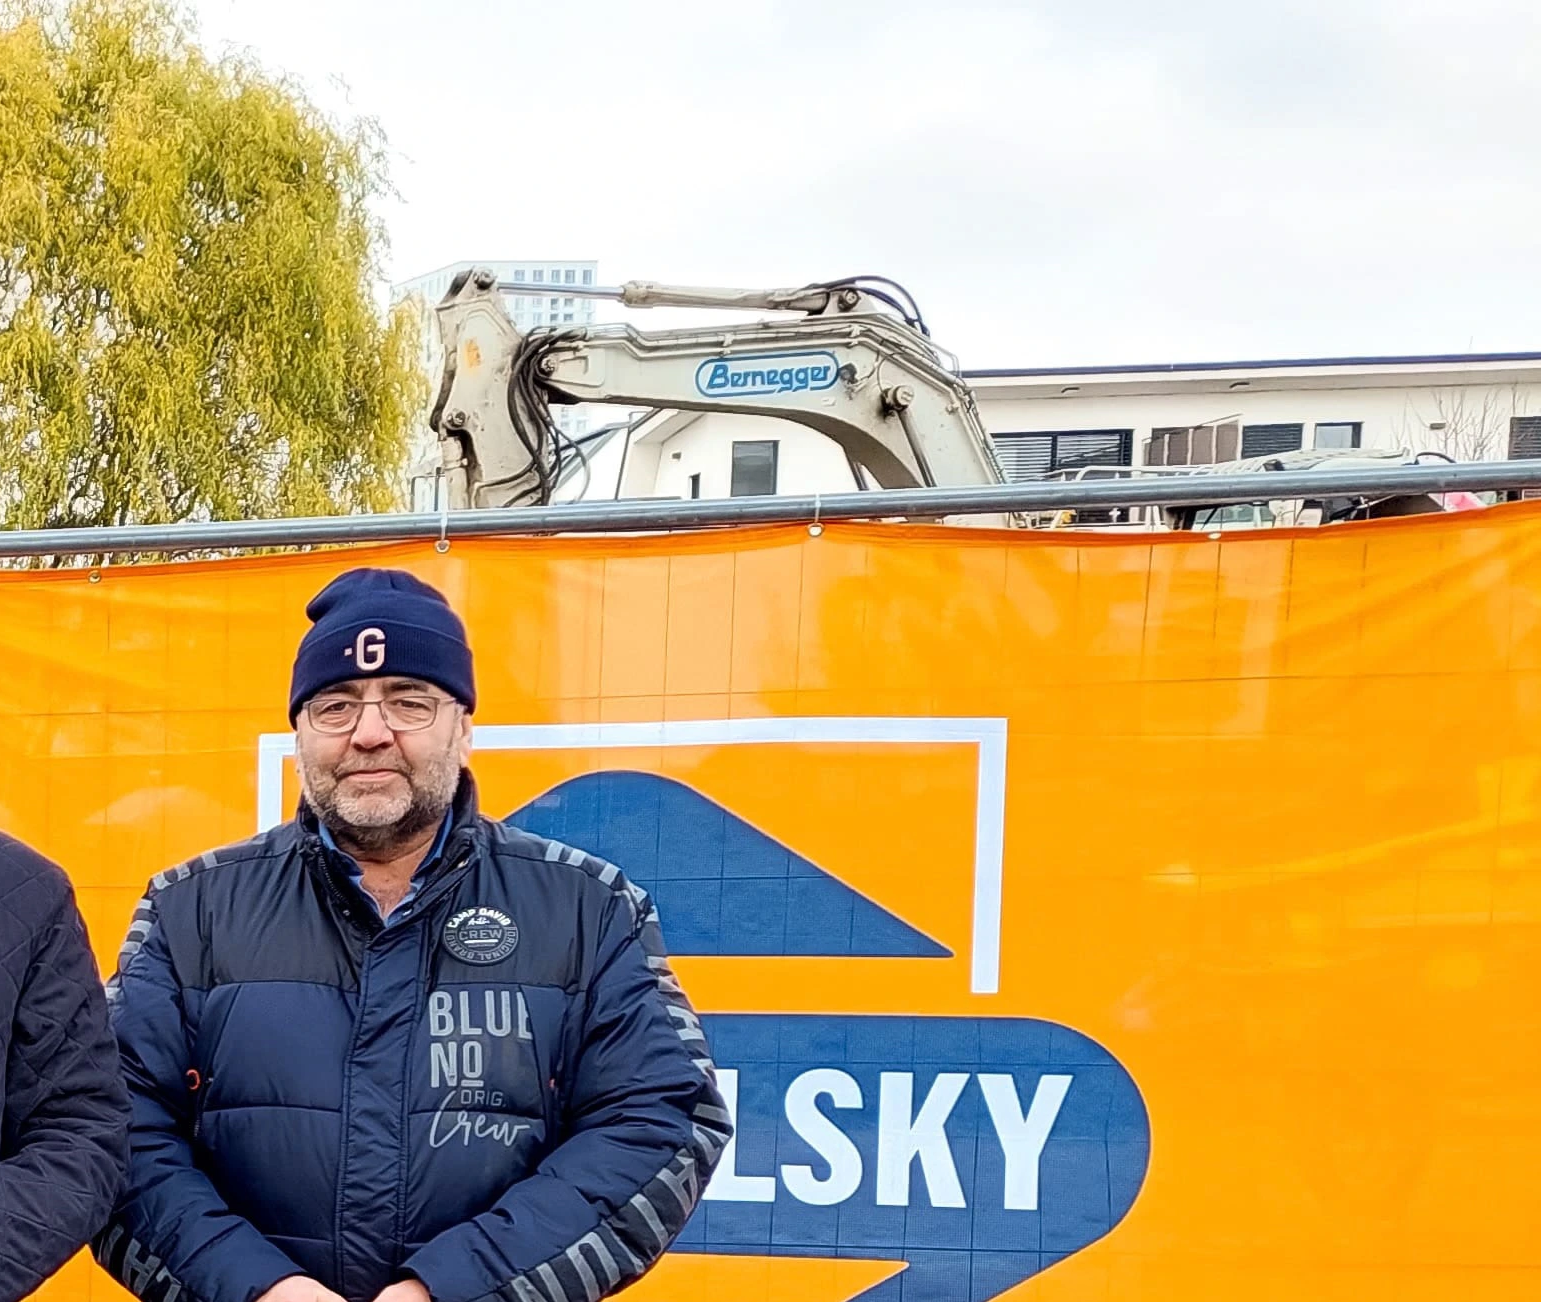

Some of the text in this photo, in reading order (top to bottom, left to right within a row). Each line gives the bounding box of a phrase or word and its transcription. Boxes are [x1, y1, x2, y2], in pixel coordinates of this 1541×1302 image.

[705, 364, 831, 393] Bernegger
[447, 908, 476, 928] CAMP
[479, 908, 511, 926] DAVID
[458, 929, 503, 941] CREW
[477, 930, 516, 960] ORIGINAL
[460, 1089, 507, 1107] ORIG.
[429, 1091, 531, 1148] Crew
[702, 1067, 1074, 1211] LSKY
